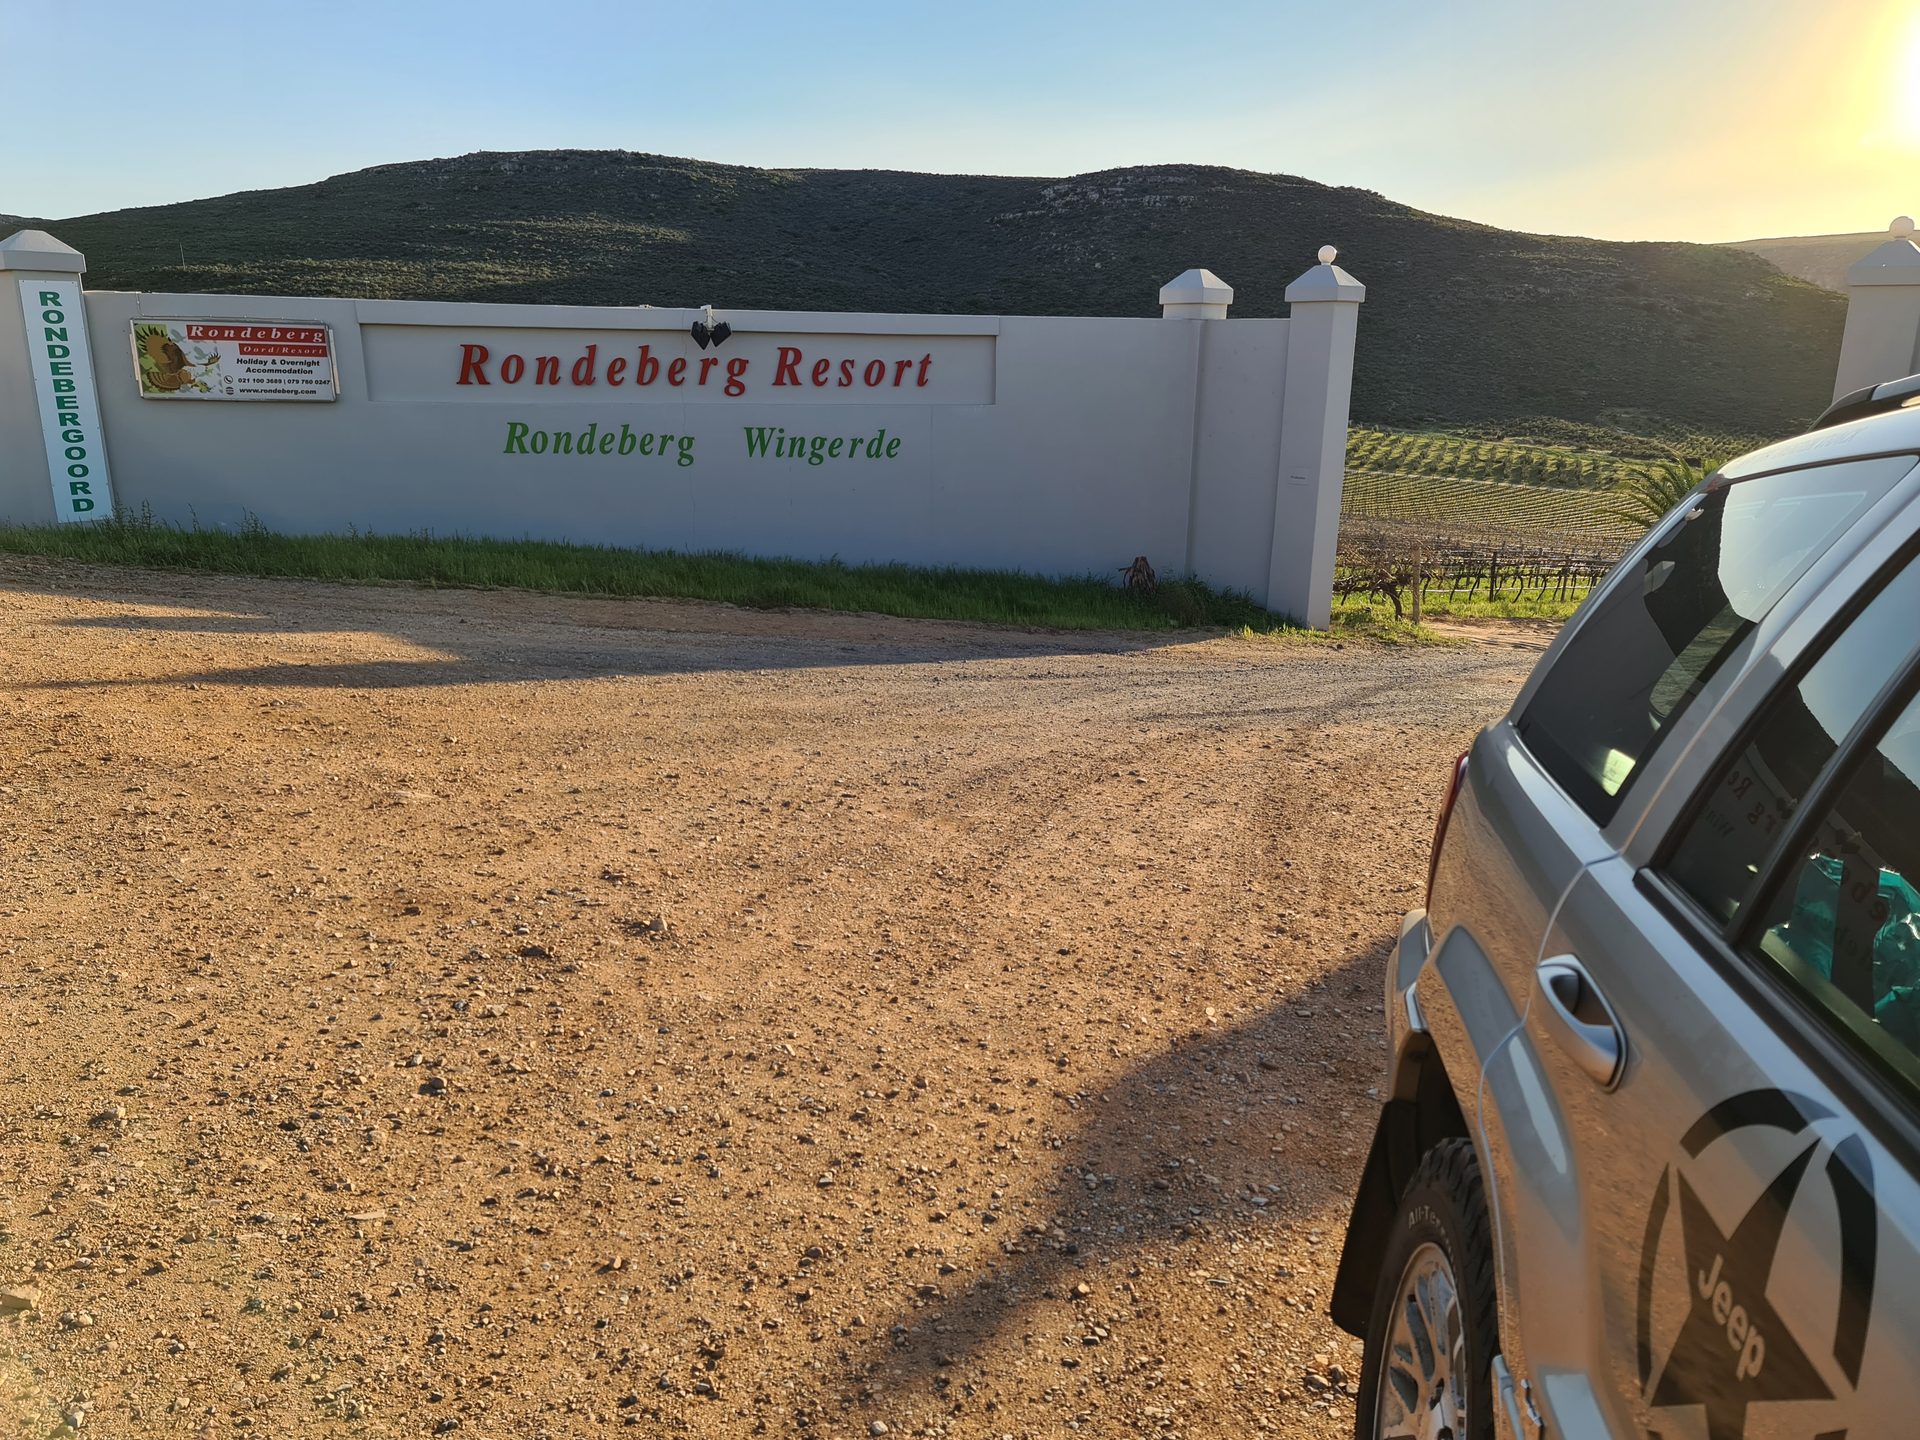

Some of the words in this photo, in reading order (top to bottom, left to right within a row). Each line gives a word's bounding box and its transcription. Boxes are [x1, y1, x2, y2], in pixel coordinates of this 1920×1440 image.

[190, 325, 323, 343] Rondeberg
[243, 345, 323, 355] Oord/Resort
[236, 358, 268, 367] Holiday
[280, 359, 320, 368] Overnight
[245, 367, 313, 375] Accommodation
[456, 343, 750, 397] Rondeberg
[771, 346, 933, 388] Resort
[38, 291, 95, 513] RONDEBERGOORD
[503, 421, 696, 467] Rondeberg
[744, 426, 902, 466] Wingerde
[1698, 1252, 1767, 1383] Jeep
